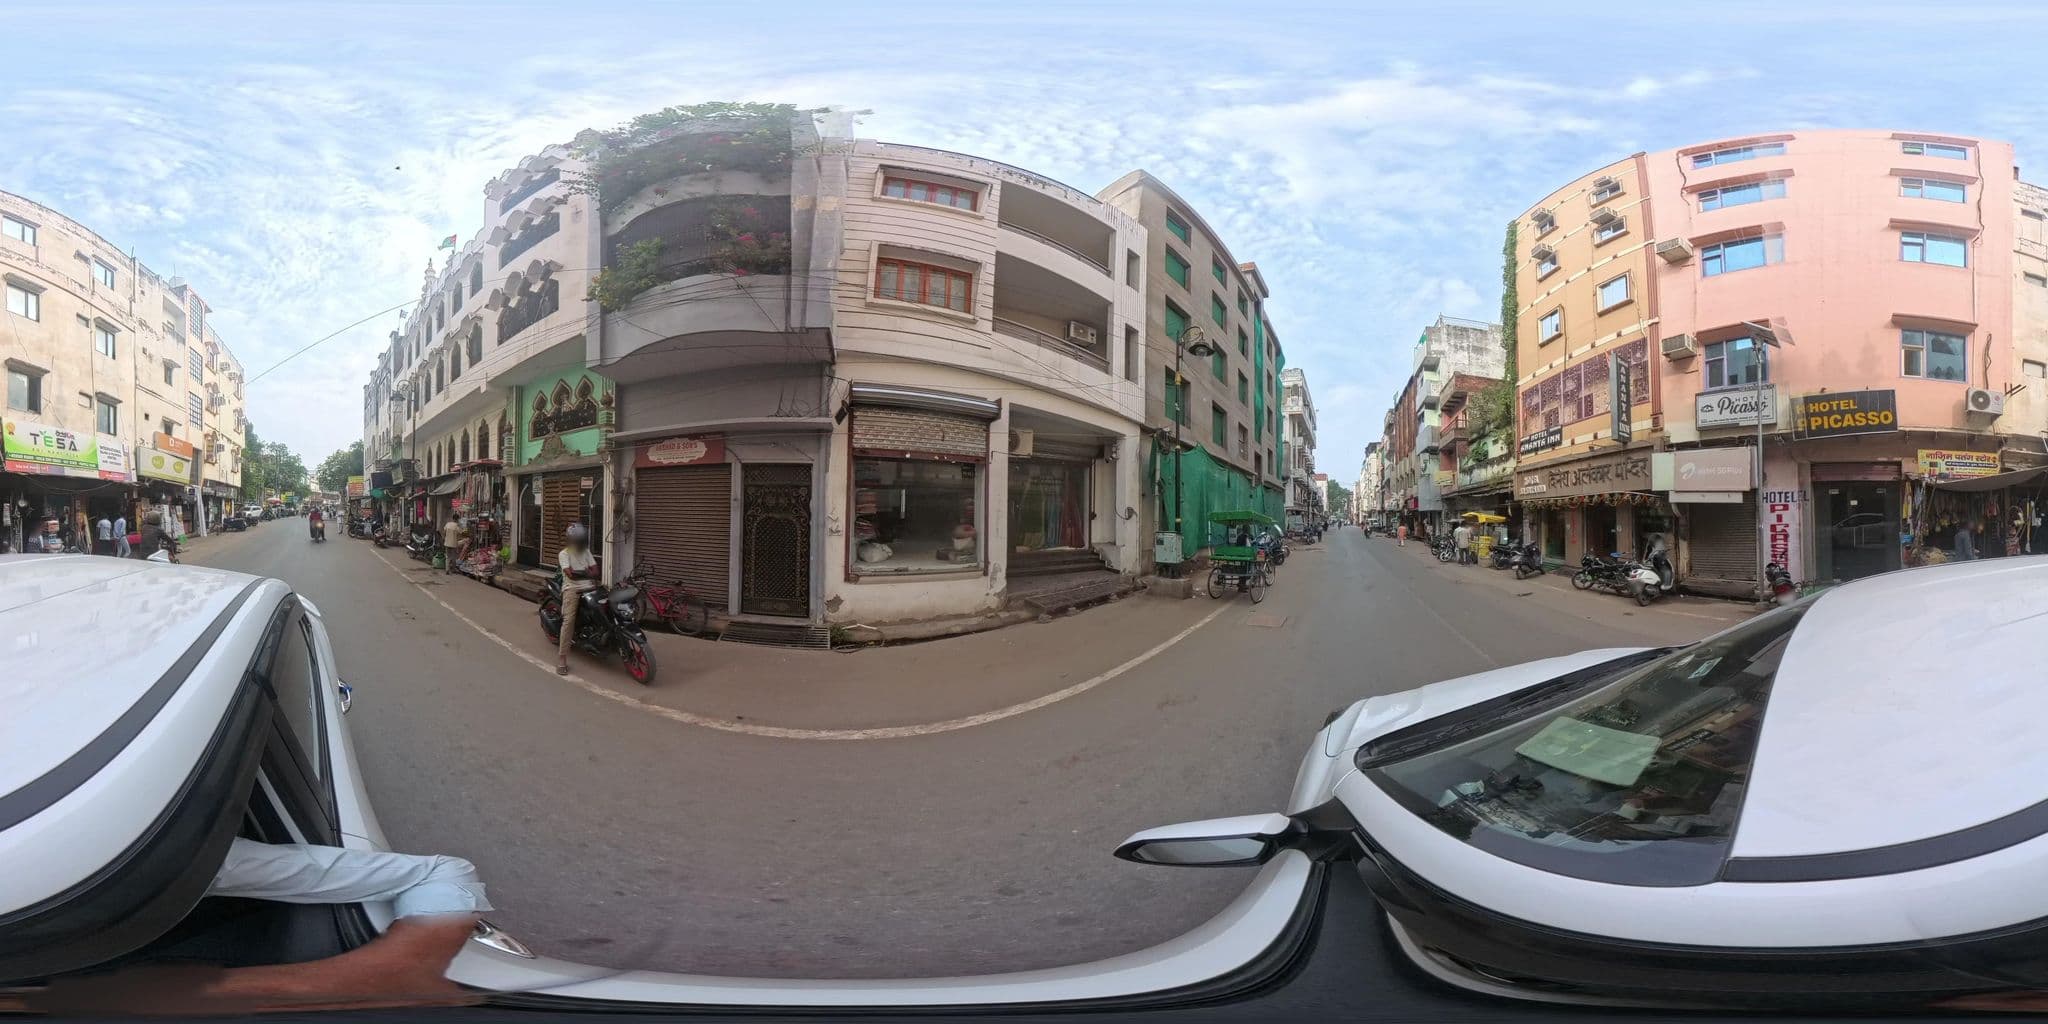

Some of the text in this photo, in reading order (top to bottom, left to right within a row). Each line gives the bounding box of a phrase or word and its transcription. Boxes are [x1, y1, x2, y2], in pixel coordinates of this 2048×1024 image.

[1735, 394, 1768, 402] HOTL
[1810, 399, 1858, 413] HOTEL
[1810, 411, 1893, 430] PICASSO
[1531, 430, 1547, 440] HOTEL
[1547, 433, 1560, 444] INN
[29, 432, 79, 452] TESA
[1762, 491, 1797, 503] HOTEL
